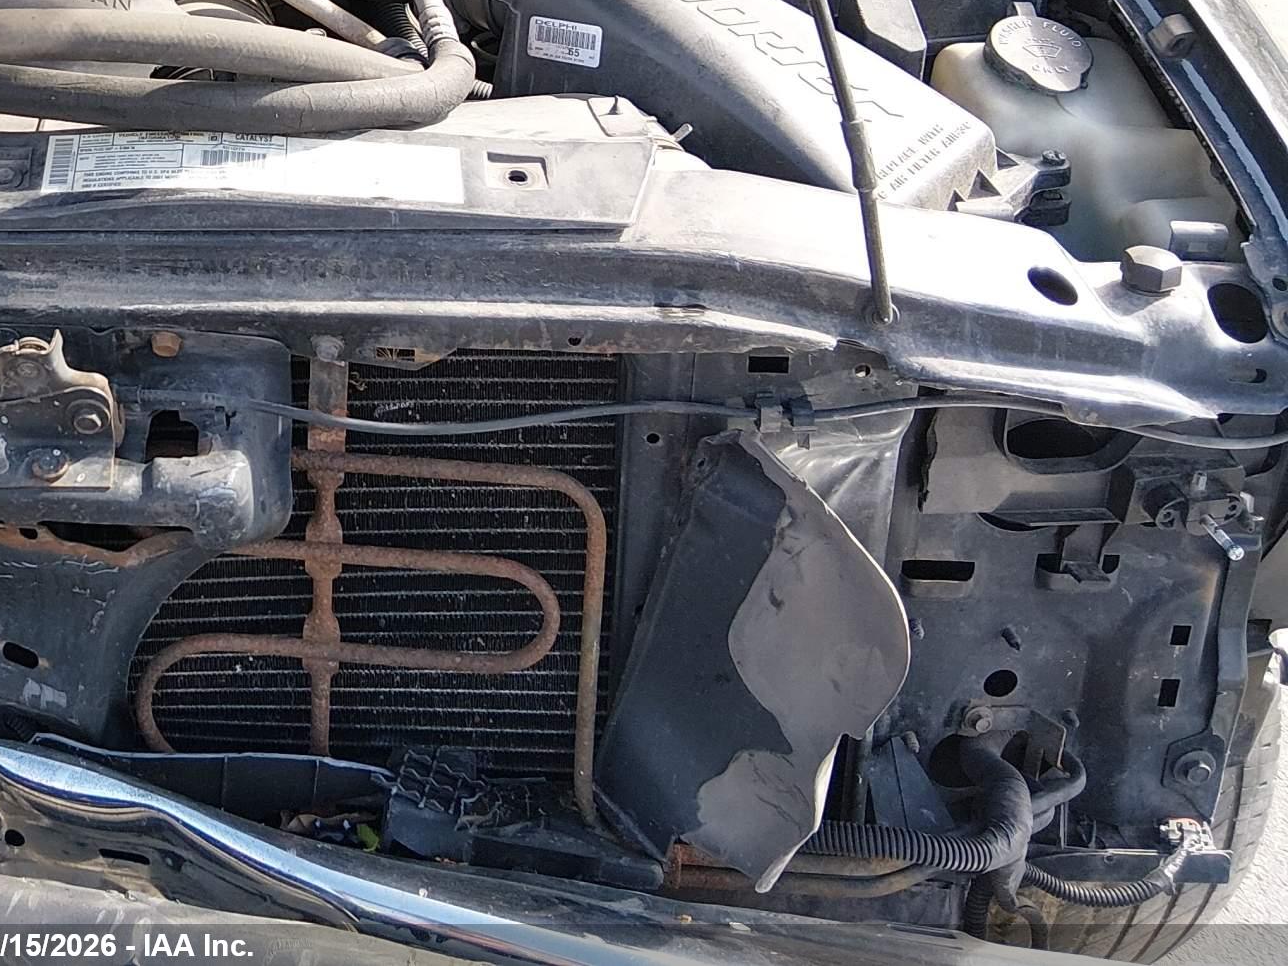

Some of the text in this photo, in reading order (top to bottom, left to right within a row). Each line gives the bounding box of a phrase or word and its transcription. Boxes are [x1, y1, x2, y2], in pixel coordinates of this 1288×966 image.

[535, 19, 578, 31] DELPHI
[1042, 21, 1082, 48] FLUID
[235, 133, 273, 142] CATALYST
